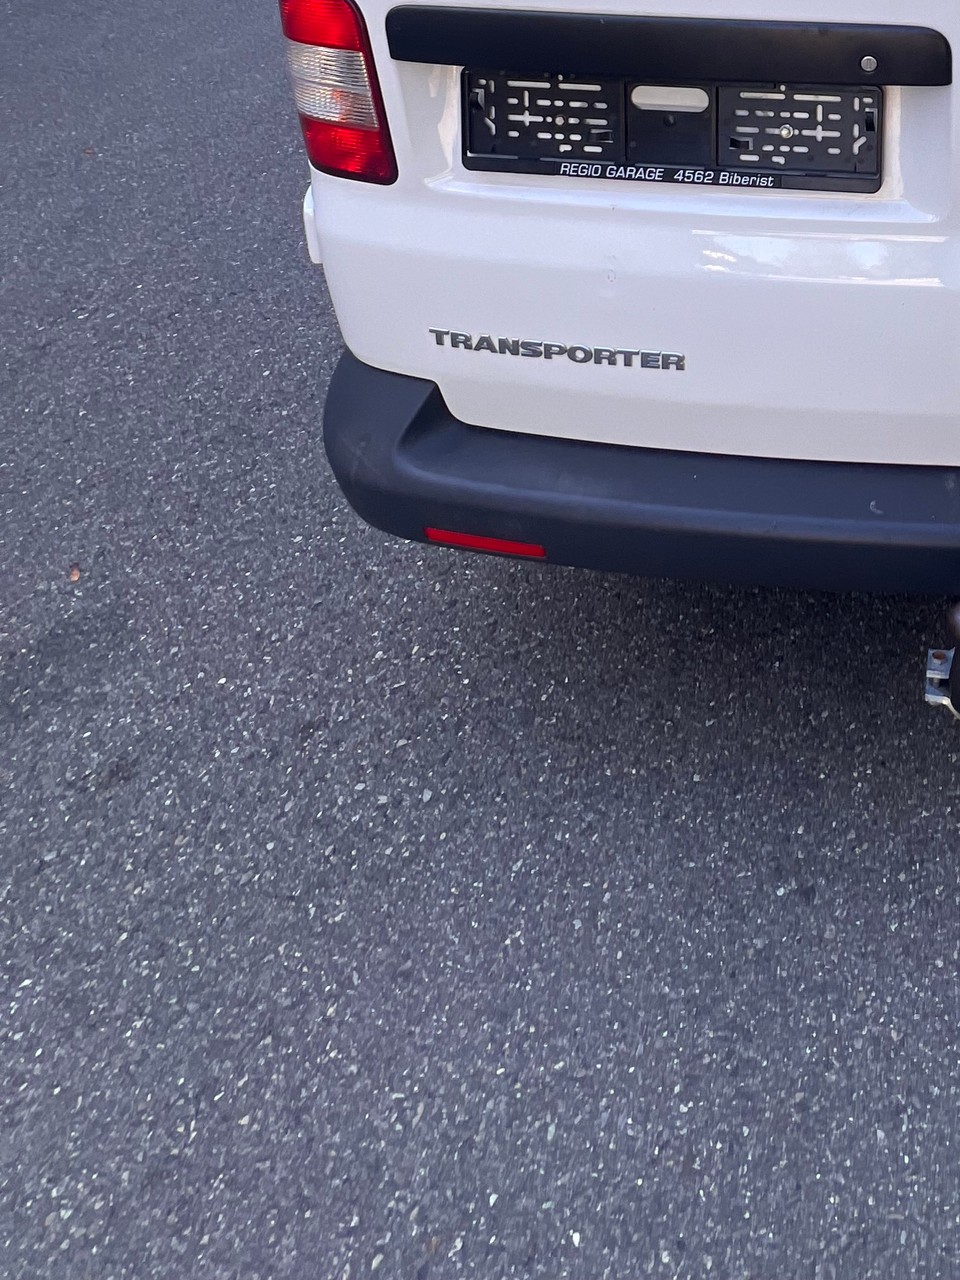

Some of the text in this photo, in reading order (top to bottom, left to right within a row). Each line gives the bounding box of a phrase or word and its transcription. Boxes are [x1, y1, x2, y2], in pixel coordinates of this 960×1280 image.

[560, 162, 775, 188] REGIO GARAGE 4562 Biberist
[428, 326, 686, 371] TRANSPORTER
